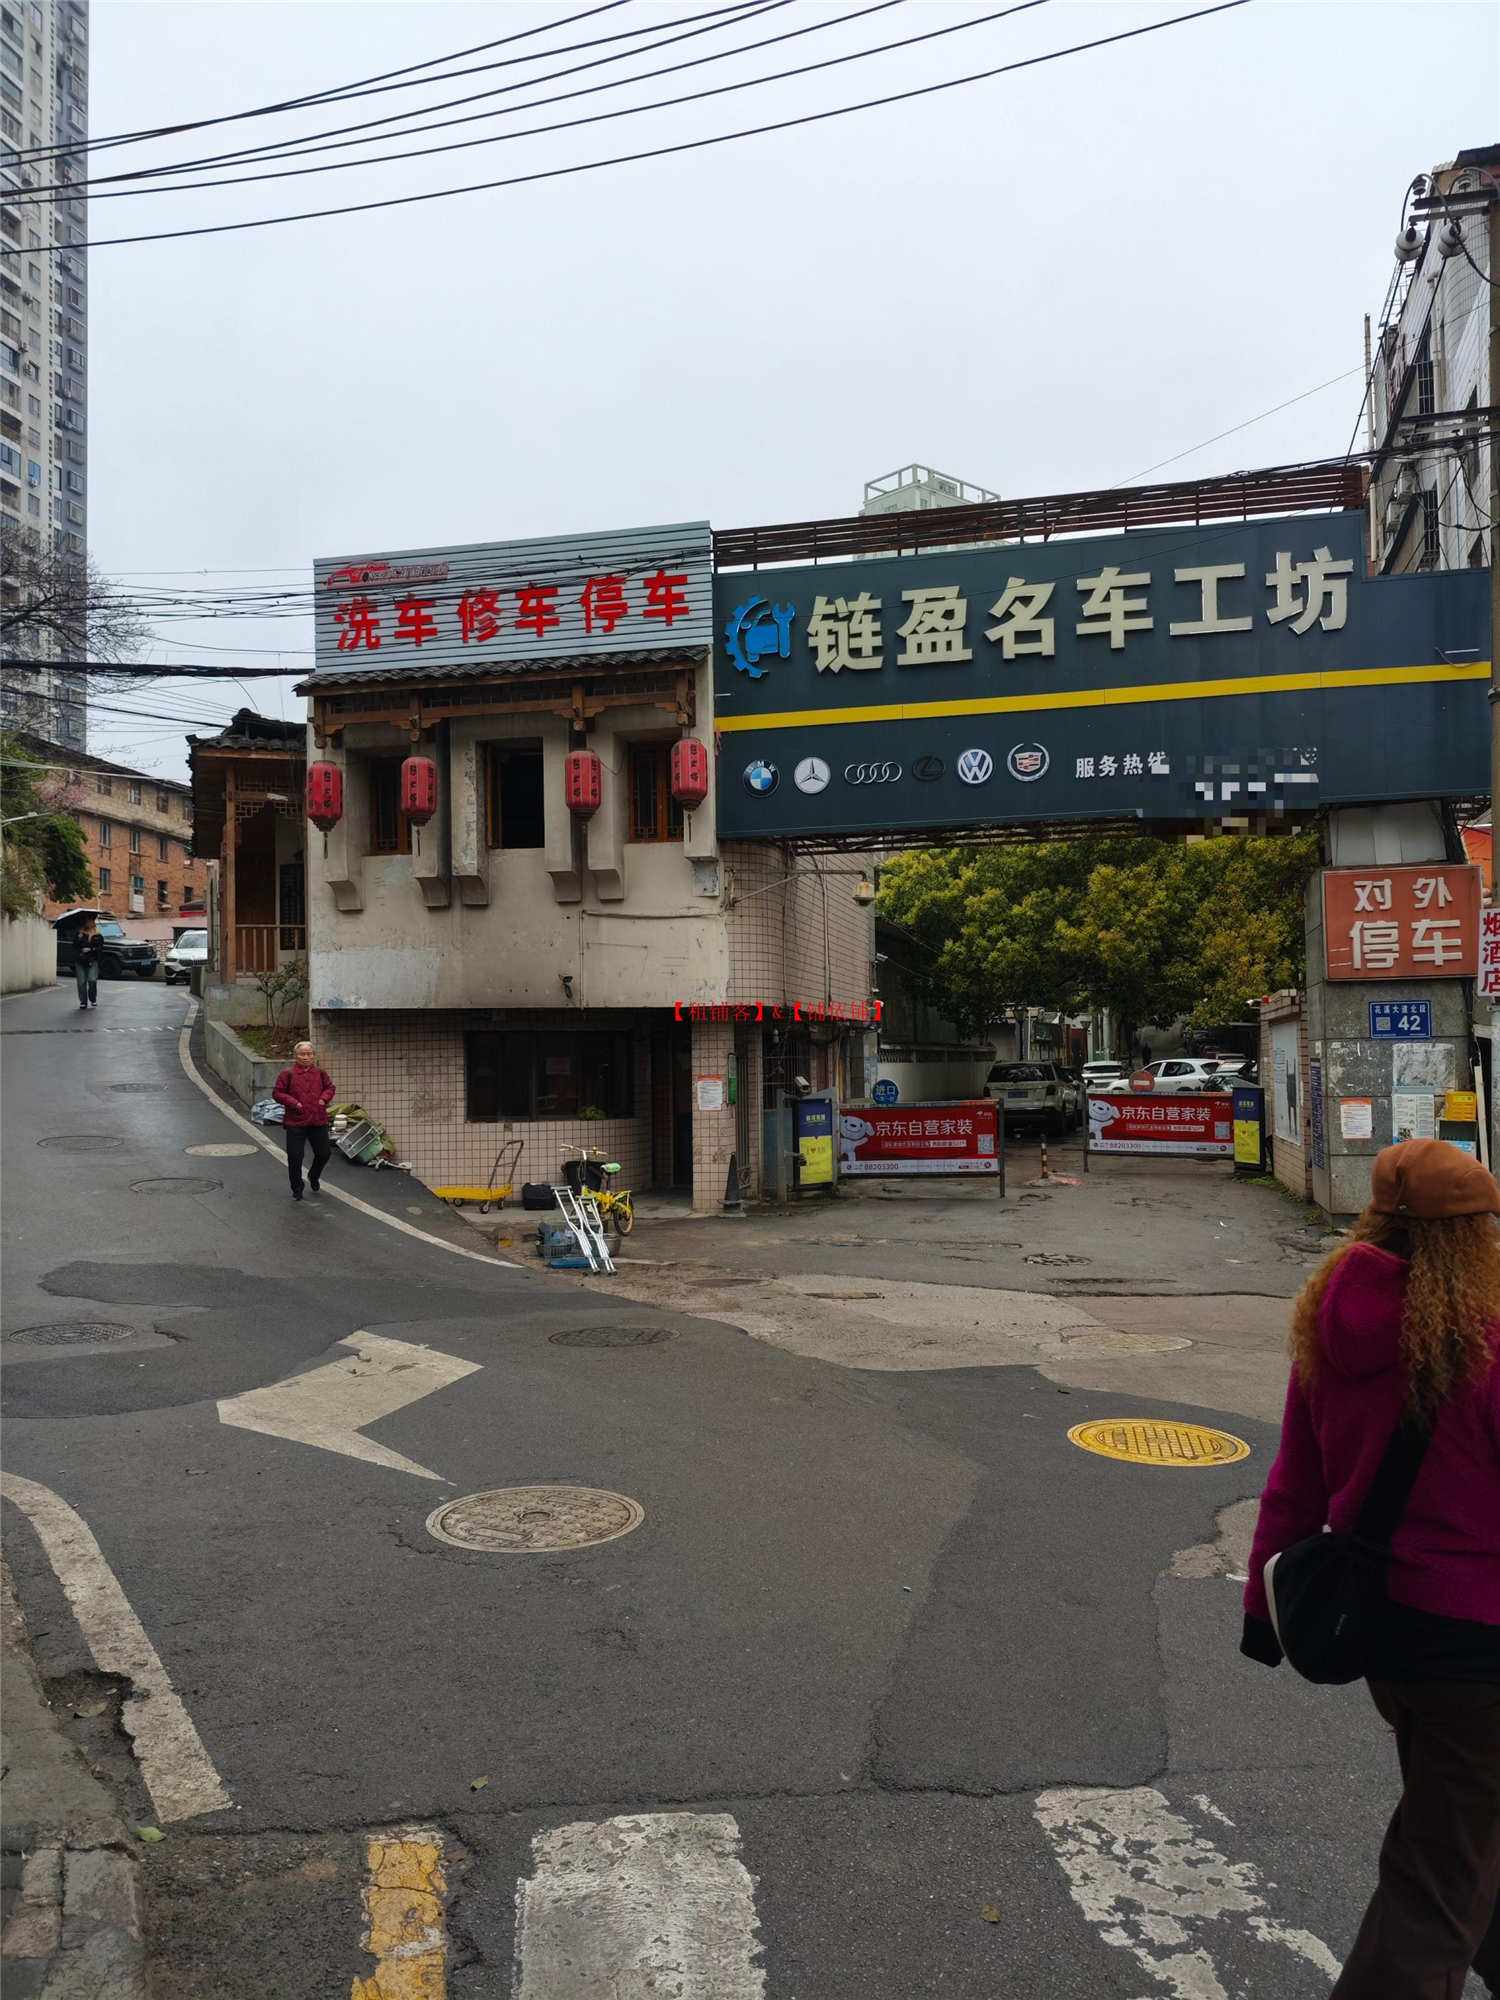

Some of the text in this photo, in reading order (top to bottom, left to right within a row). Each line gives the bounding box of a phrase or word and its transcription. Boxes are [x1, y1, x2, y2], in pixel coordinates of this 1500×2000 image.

[333, 568, 691, 651] 洗车修车停车
[807, 546, 1354, 673] 链盈名车工坊
[1353, 876, 1453, 912] 对外
[1349, 919, 1463, 969] 停车
[1481, 911, 1500, 994] 烟酒店
[1398, 1015, 1421, 1031] 42
[875, 1084, 896, 1095] 进口
[875, 1119, 974, 1137] 京东自营家装
[1122, 1106, 1212, 1121] 京东自营家装
